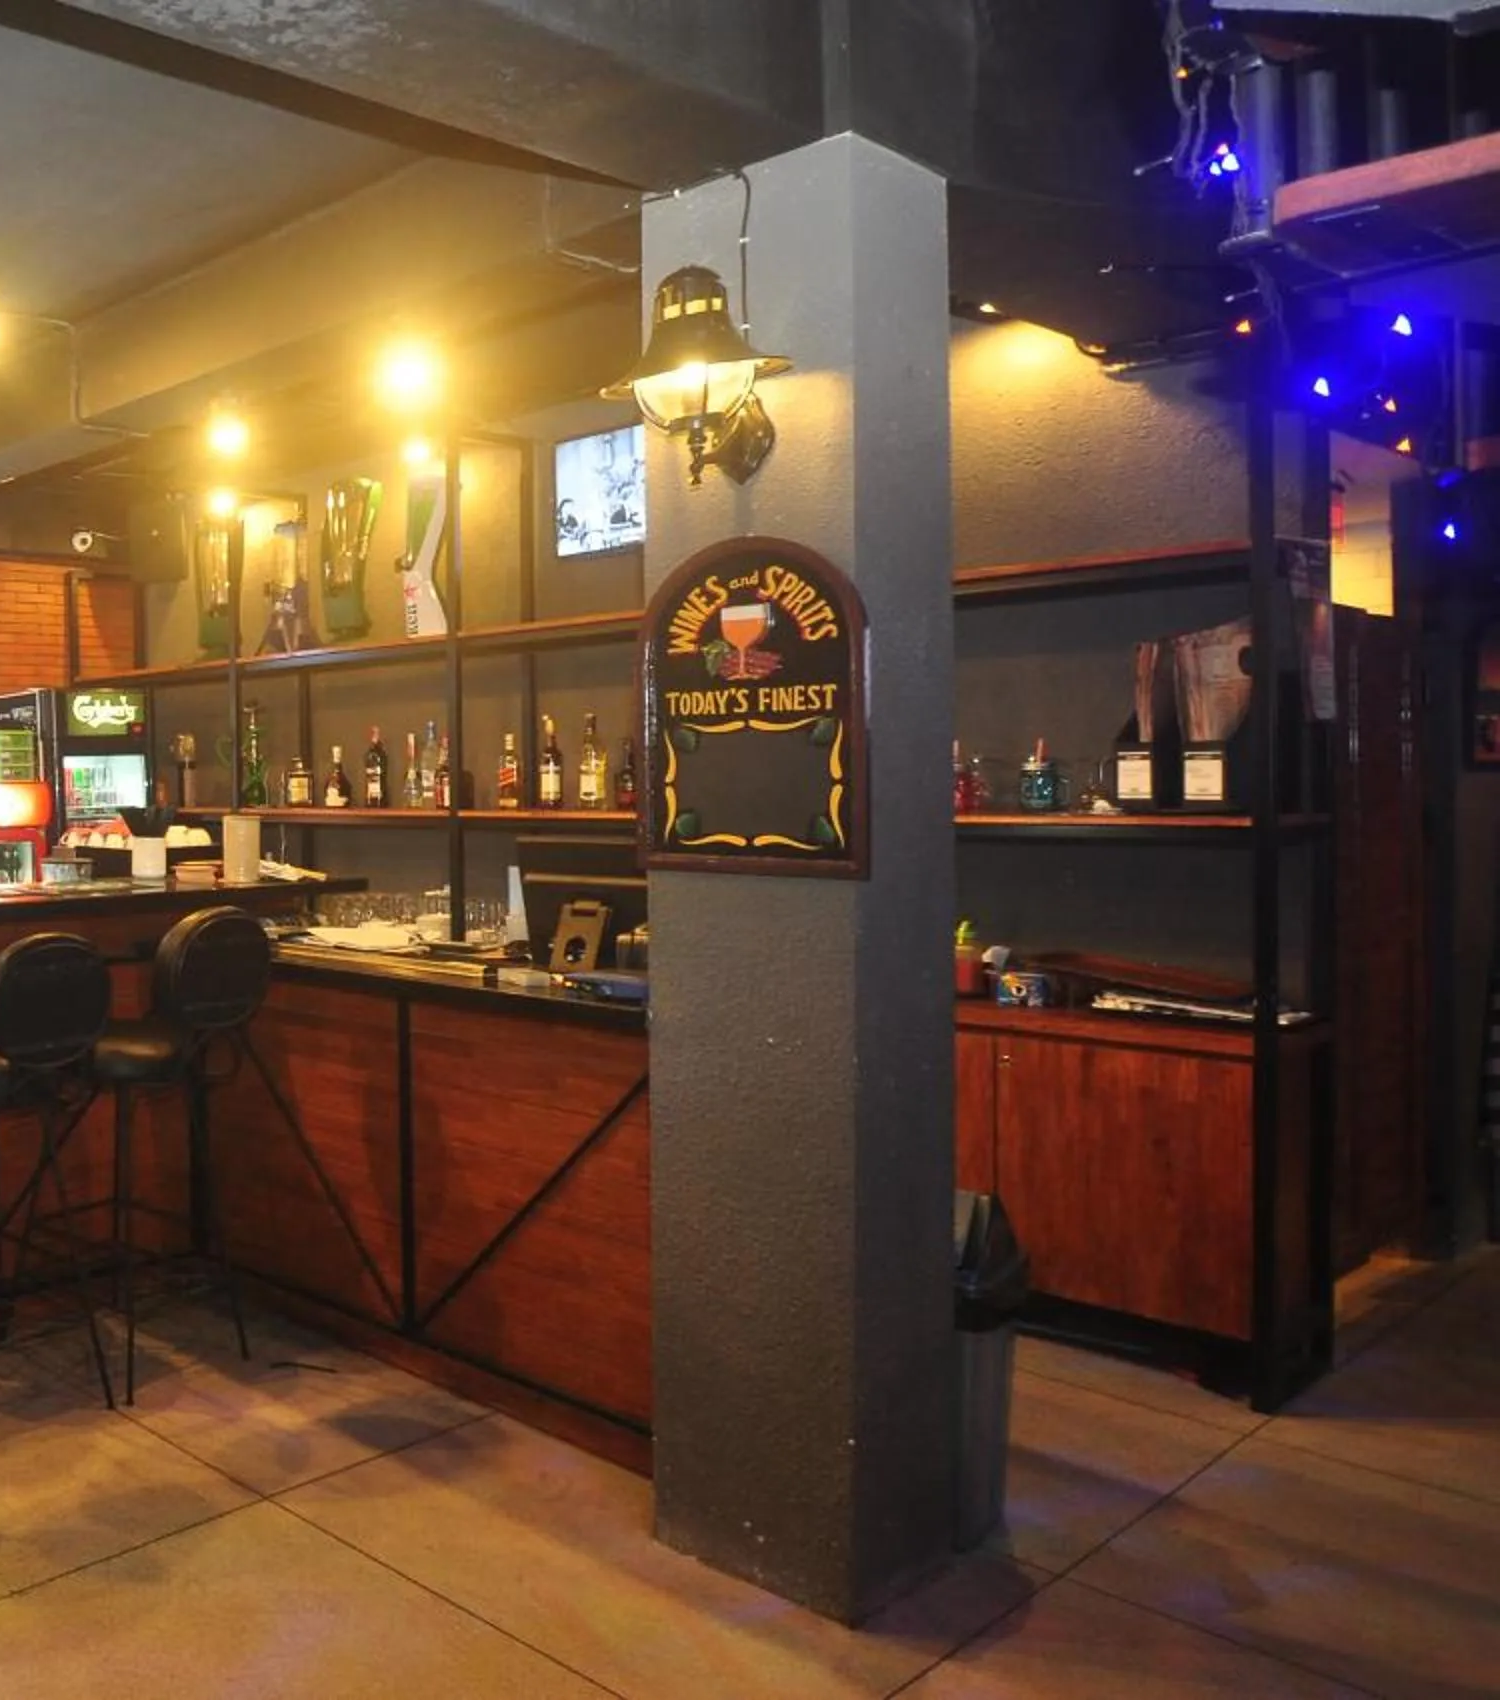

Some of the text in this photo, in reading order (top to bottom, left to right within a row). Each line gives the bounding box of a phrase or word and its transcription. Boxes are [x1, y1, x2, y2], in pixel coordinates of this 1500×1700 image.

[667, 565, 839, 654] WINES and SPIRITS
[72, 695, 139, 728] Carlsberg
[666, 684, 838, 716] TODAY'S FINEST
